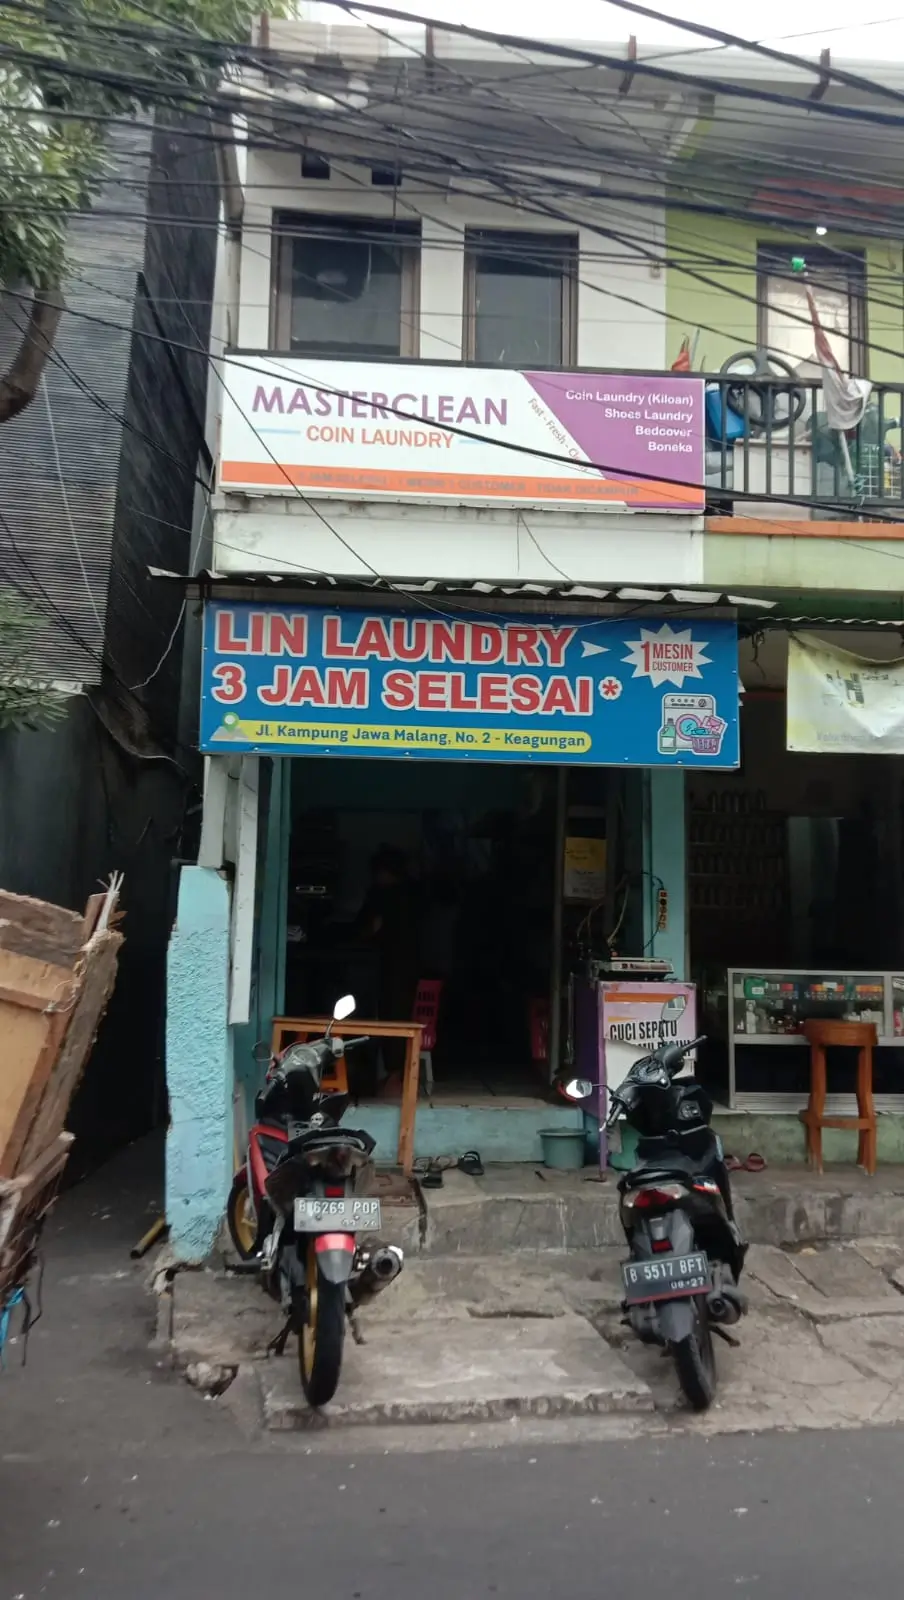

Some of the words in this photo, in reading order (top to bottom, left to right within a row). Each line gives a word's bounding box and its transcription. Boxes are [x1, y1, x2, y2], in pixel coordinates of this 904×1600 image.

[252, 385, 507, 426] MASTERCLEAN
[566, 390, 593, 401] Coin
[596, 391, 645, 406] Laundry
[648, 394, 694, 407] (Kiloan)
[528, 398, 544, 417] Fast
[546, 420, 566, 445] Fresh
[604, 408, 641, 420] Shoes
[644, 411, 693, 424] Laundry
[306, 425, 354, 444] COIN
[362, 428, 454, 449] LAUNDRY
[635, 425, 693, 438] Bedcover
[648, 441, 693, 453] Boneka
[216, 611, 308, 657] LIN
[323, 615, 578, 667] LAUNDRY
[641, 641, 650, 673] 1
[653, 643, 693, 660] MESIN
[652, 661, 694, 672] CUSTOMER
[212, 662, 247, 704] 3
[257, 665, 369, 708] JAM
[256, 725, 273, 738] Jl.
[277, 725, 348, 742] Kampung
[352, 728, 390, 741] Jawa
[394, 729, 451, 745] Malang,
[455, 732, 478, 744] No.
[482, 734, 491, 744] 2
[504, 733, 586, 749] Keagungan
[610, 1023, 636, 1041] CUCI
[639, 1020, 678, 1040] SEPATU
[299, 1200, 307, 1212] B
[313, 1201, 345, 1214] 6269
[630, 1268, 638, 1283] B
[643, 1262, 674, 1280] 5517
[680, 1257, 703, 1273] BFT
